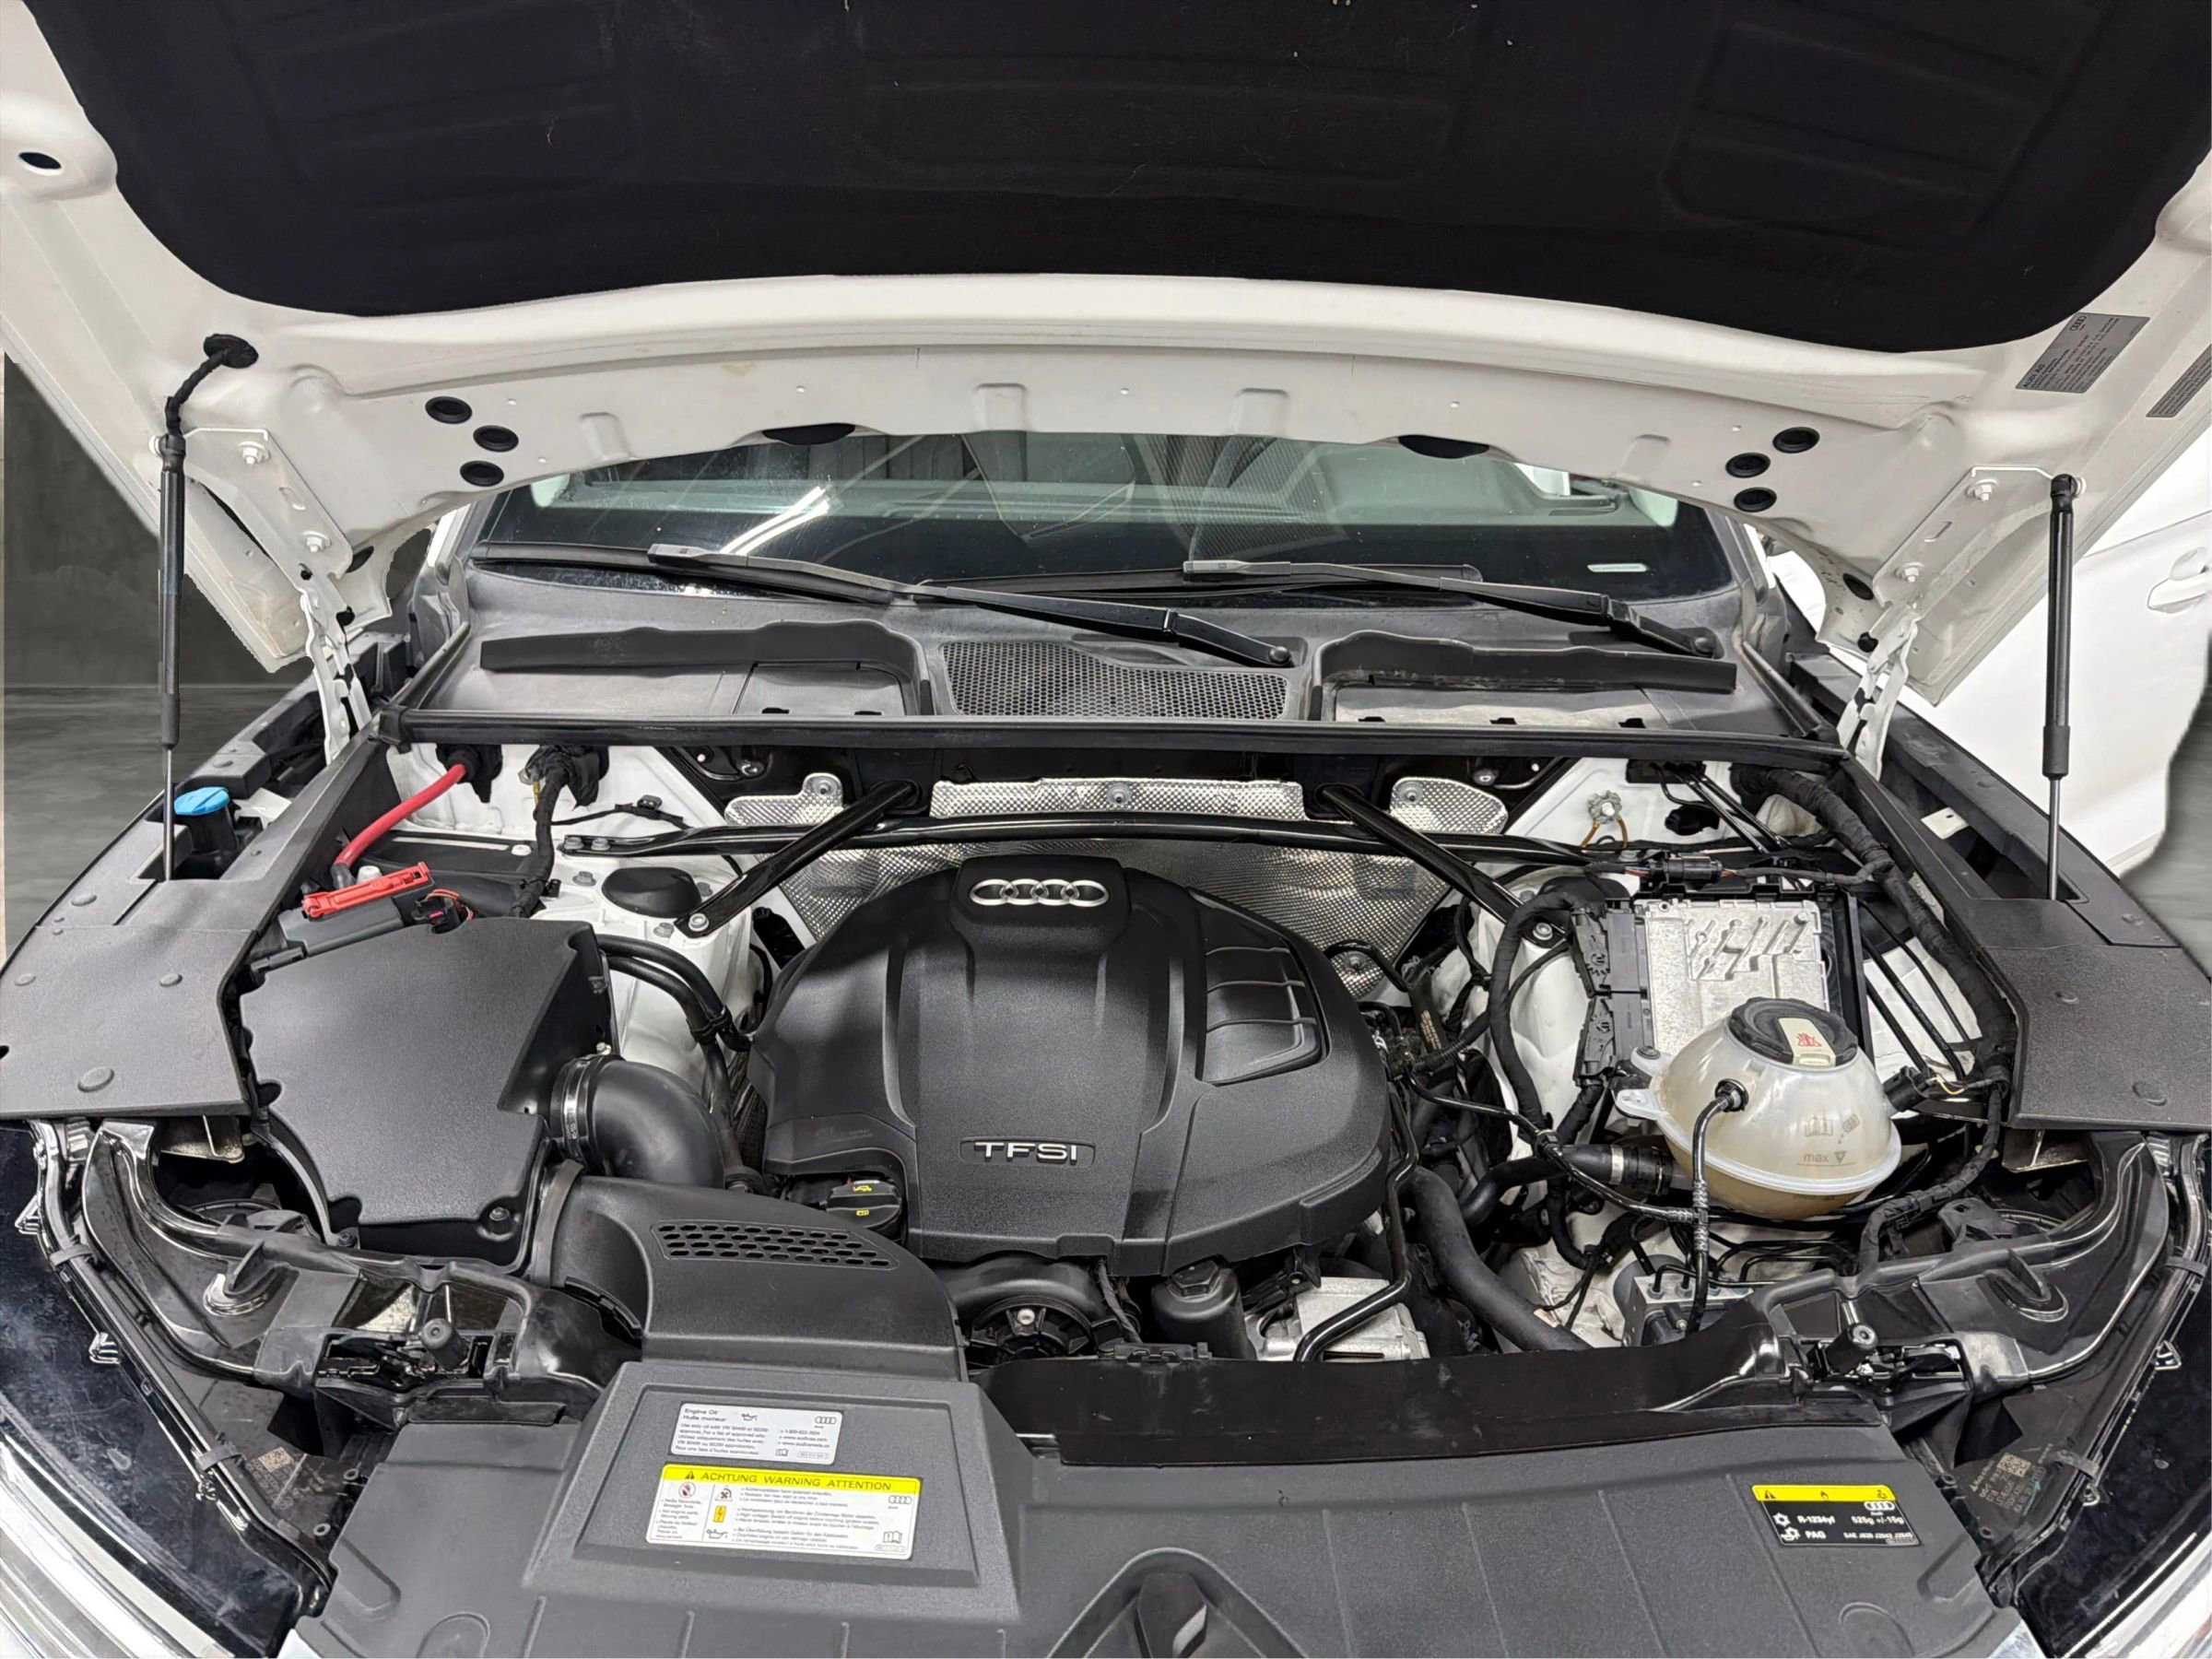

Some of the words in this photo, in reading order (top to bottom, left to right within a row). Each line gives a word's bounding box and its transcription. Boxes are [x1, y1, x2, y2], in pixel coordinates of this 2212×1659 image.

[974, 1141, 1077, 1163] TFSI
[1803, 1153, 1830, 1163] max
[700, 1472, 758, 1483] ACHTUNG
[763, 1475, 821, 1487] WARNING
[826, 1479, 891, 1490] ATTENTION
[1797, 1515, 1836, 1525] R-1234yf
[1805, 1530, 1827, 1539] PAG
